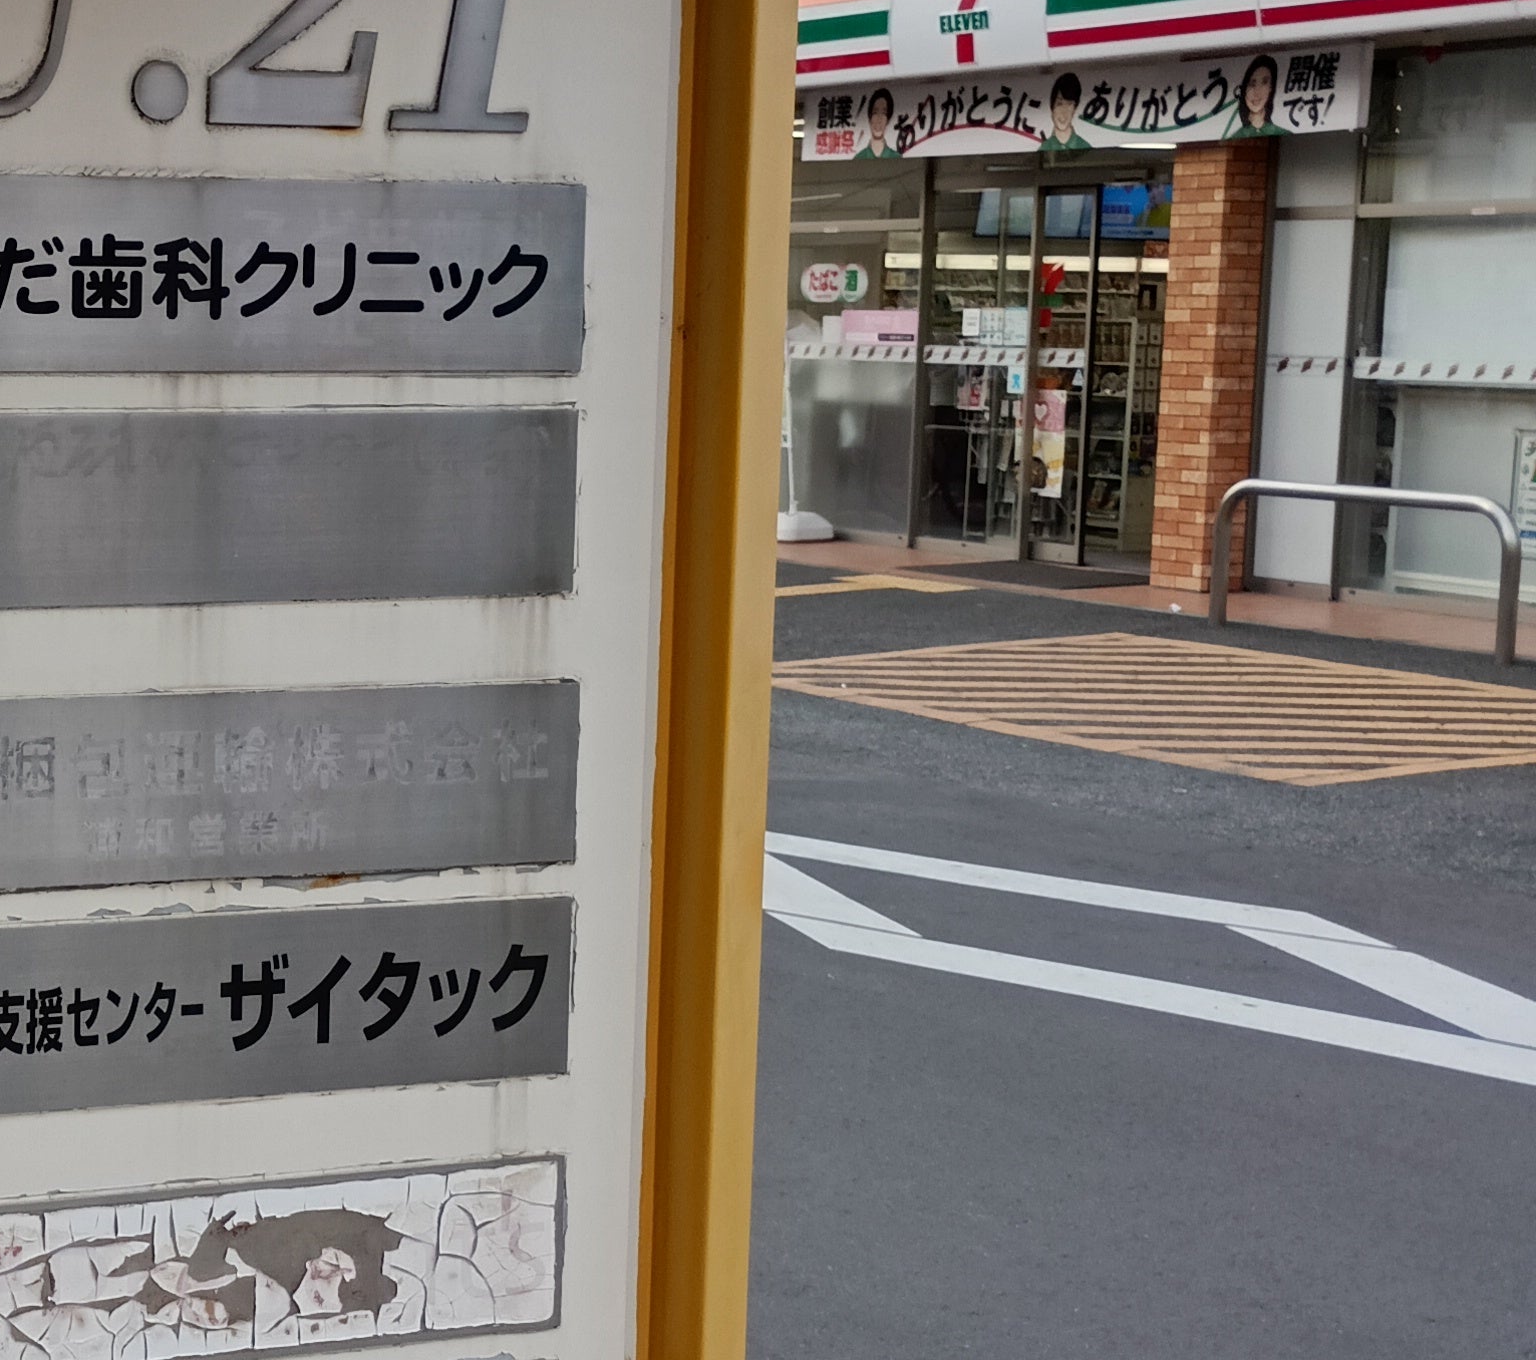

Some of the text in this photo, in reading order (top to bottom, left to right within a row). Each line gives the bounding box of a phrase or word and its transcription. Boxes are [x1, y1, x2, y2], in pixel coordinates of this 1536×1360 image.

[1083, 67, 1228, 132] ありがとう
[1284, 52, 1340, 93] 開催
[219, 943, 551, 1052] ザイタック
